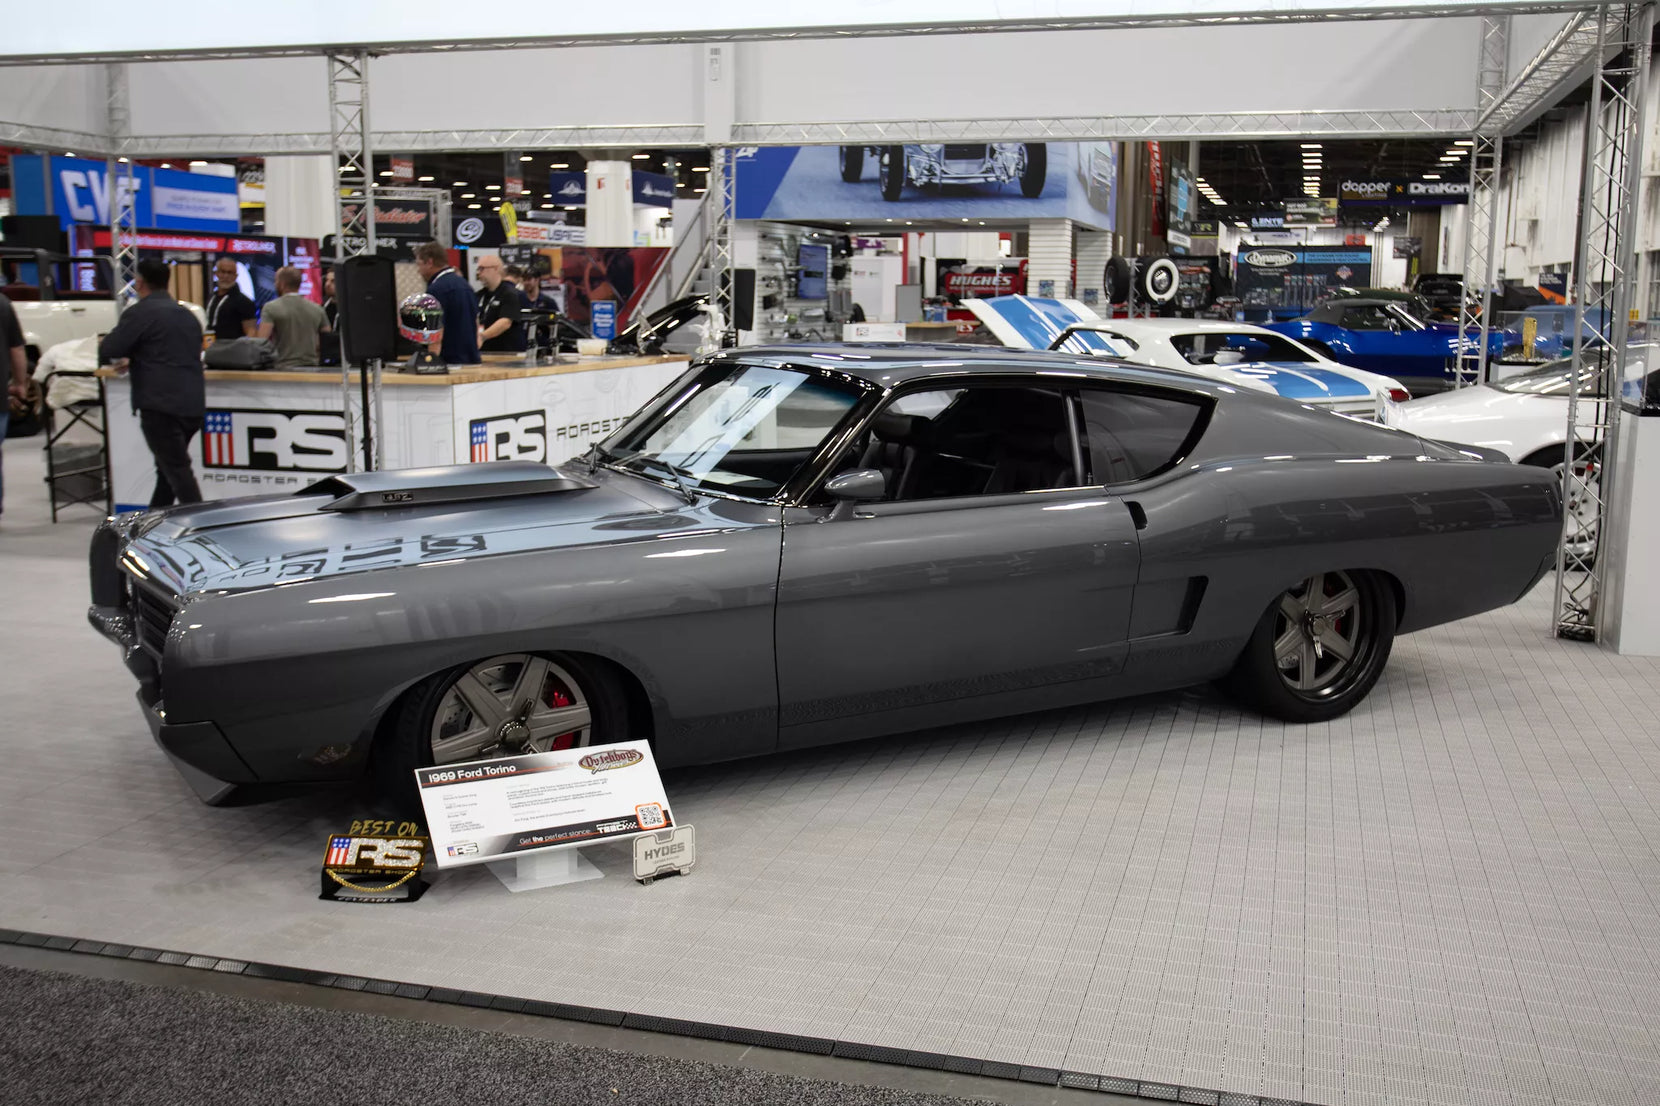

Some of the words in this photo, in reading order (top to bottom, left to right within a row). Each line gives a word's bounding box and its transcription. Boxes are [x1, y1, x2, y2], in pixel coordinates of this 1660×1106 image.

[1341, 180, 1391, 194] dapper
[949, 275, 1012, 287] HUGHES
[202, 473, 298, 485] ROADSTER
[428, 770, 456, 784] 1969
[457, 767, 483, 780] Ford
[483, 764, 517, 776] Torino
[348, 819, 395, 836] BEST
[397, 821, 419, 838] ON
[519, 837, 532, 846] Get
[532, 835, 544, 843] the
[544, 831, 568, 843] perfect
[644, 842, 685, 861] HYDES
